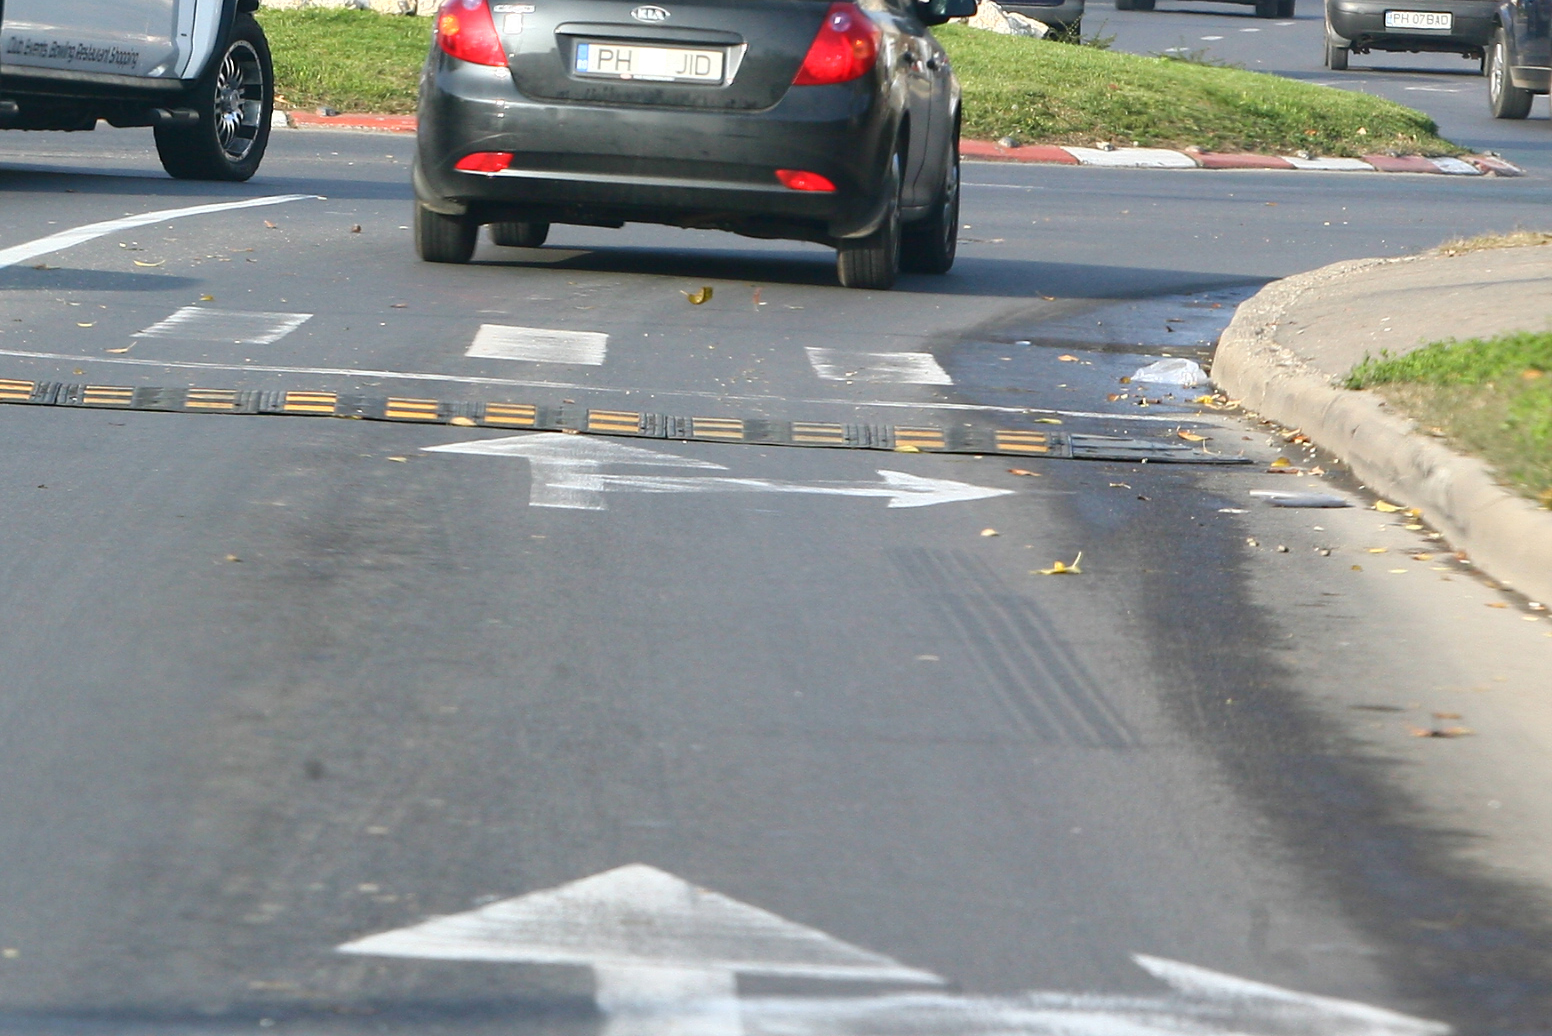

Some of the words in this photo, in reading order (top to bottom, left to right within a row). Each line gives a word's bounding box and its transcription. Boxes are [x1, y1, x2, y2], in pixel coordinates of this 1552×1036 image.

[1394, 14, 1409, 24] PH
[598, 49, 631, 71] PH
[676, 54, 710, 75] JID
